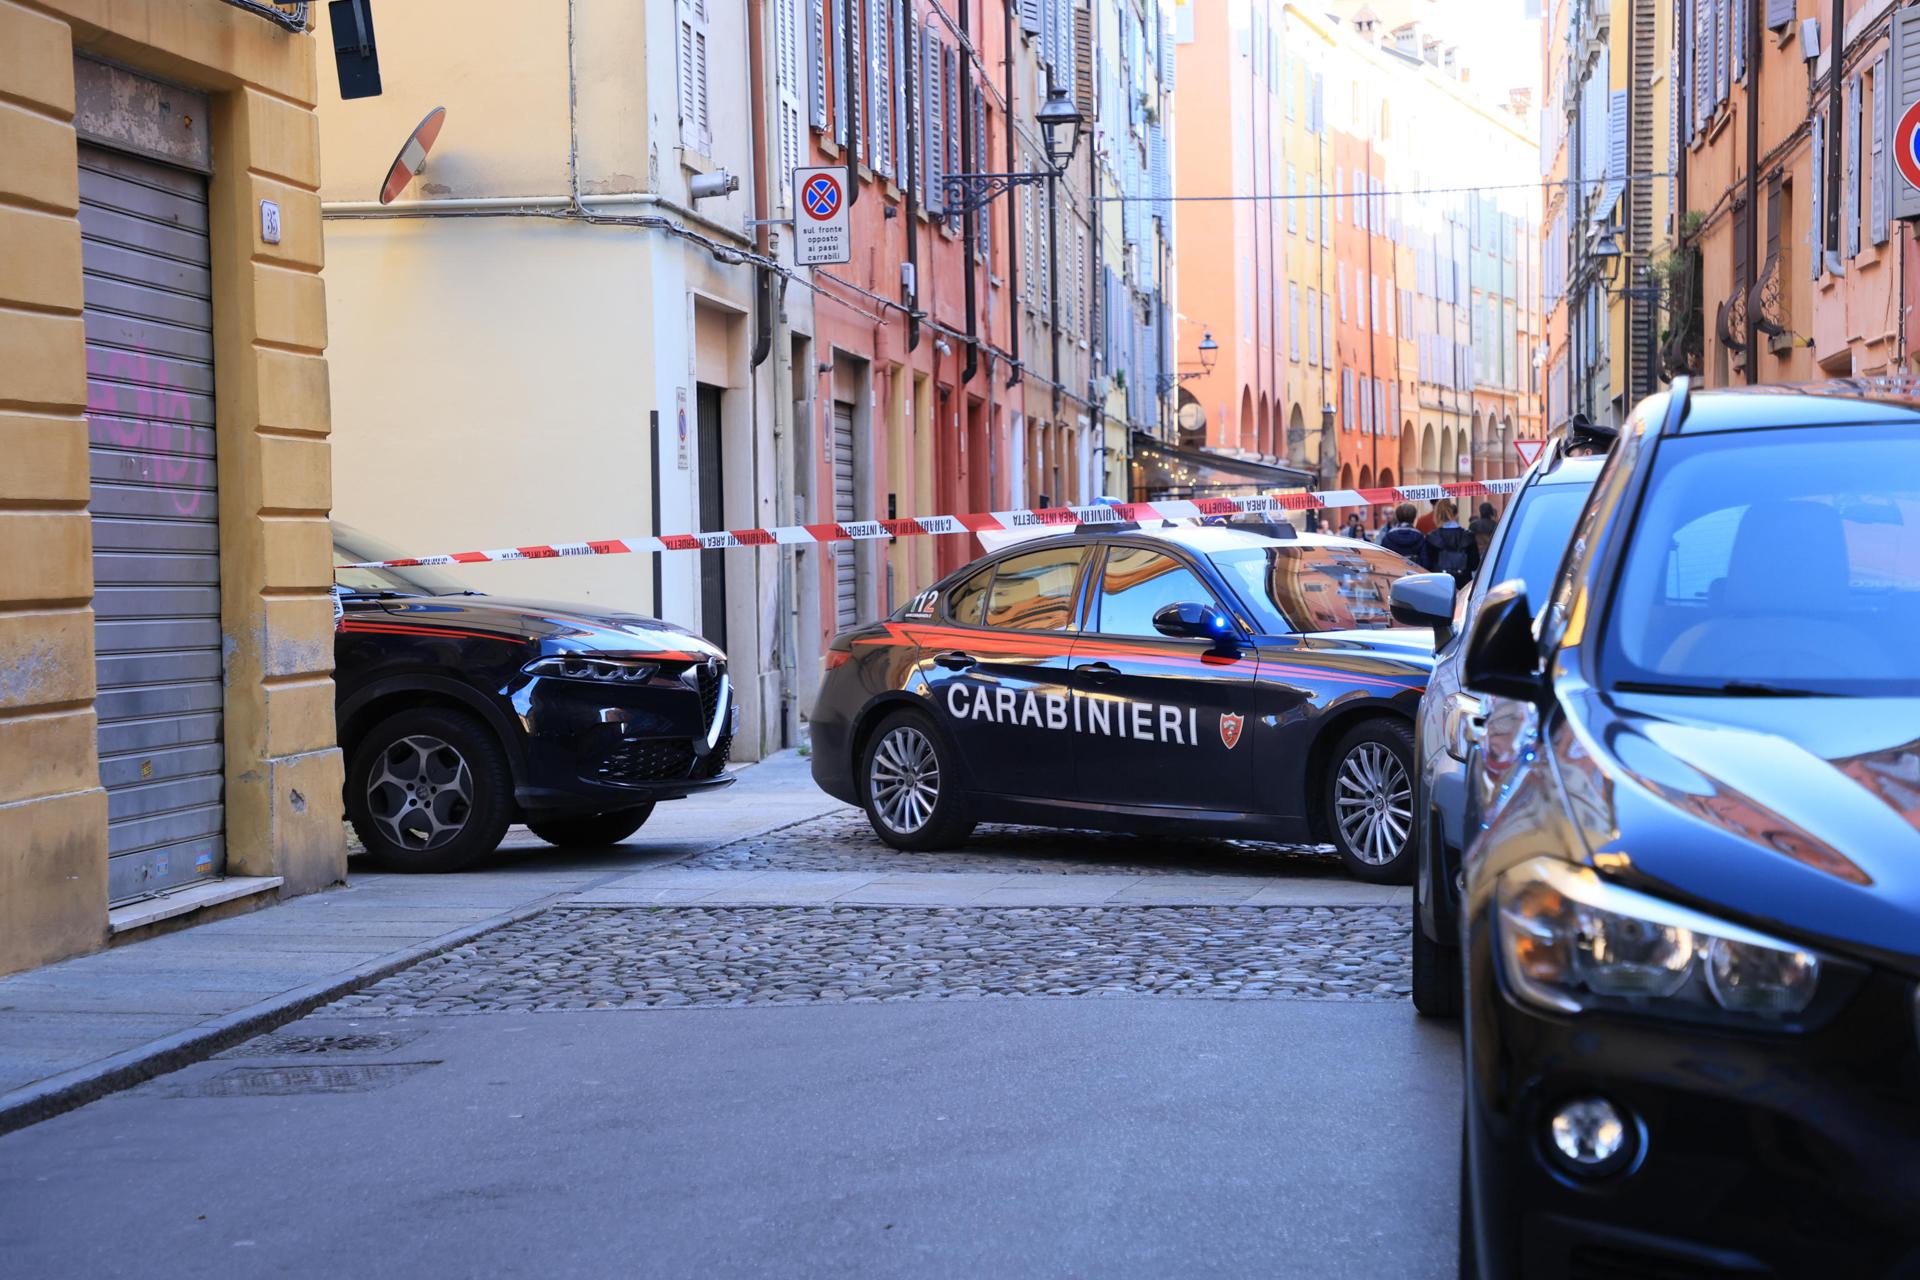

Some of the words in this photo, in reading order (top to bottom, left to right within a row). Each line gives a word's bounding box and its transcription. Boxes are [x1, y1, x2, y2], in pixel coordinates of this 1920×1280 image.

[808, 236, 838, 244] opposto
[819, 244, 838, 252] passi
[808, 253, 839, 261] carrabili
[1391, 487, 1439, 501] INTERDETTA
[1198, 500, 1244, 515] INTERDETTA
[1246, 499, 1267, 512] AREA
[1269, 495, 1325, 511] CARABINIERI
[1013, 513, 1056, 526] INTERDETTA
[1058, 511, 1078, 523] AREA
[1080, 507, 1135, 523] CARABINIERI
[835, 525, 877, 538] INTERDETTA
[879, 523, 898, 535] AREA
[900, 519, 951, 534] CARABINIERI
[665, 538, 706, 550] INTERDETTA
[707, 536, 726, 547] AREA
[727, 531, 777, 546] CARABINIERI
[911, 591, 938, 613] 112
[947, 682, 1198, 746] CARABINIERI
